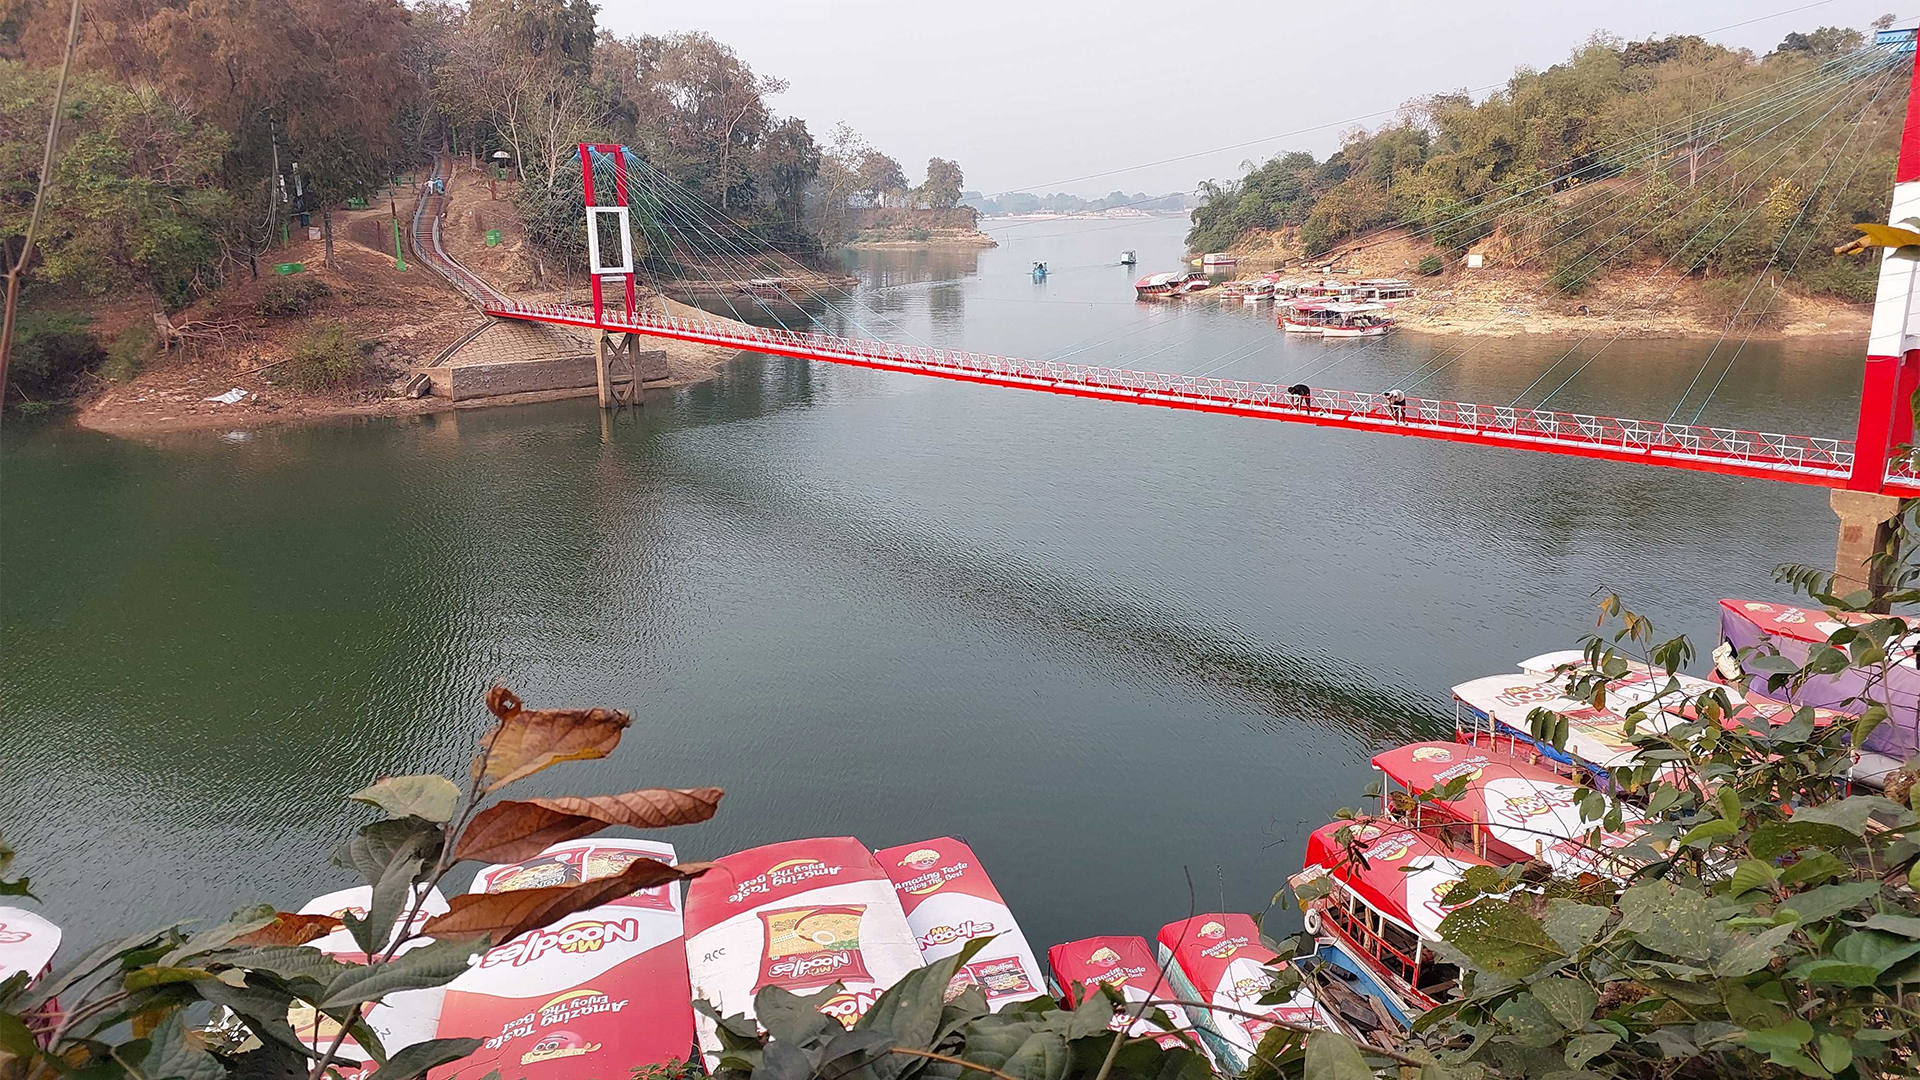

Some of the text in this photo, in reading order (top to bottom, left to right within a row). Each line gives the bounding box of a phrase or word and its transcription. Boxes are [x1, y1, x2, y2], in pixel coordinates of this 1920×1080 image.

[727, 864, 842, 903] Amazing Taste
[738, 863, 825, 891] Enjoy The Best
[895, 861, 968, 891] Amazing Taste
[904, 870, 963, 893] Enjoy The Best
[484, 919, 638, 968] Noodles
[560, 939, 602, 952] Mr.
[916, 921, 993, 950] Noodles
[770, 951, 850, 977] Noodles
[811, 965, 832, 974] Mr.
[485, 1000, 629, 1050] Amazing Taste
[501, 995, 609, 1034] Enjoy The Best
